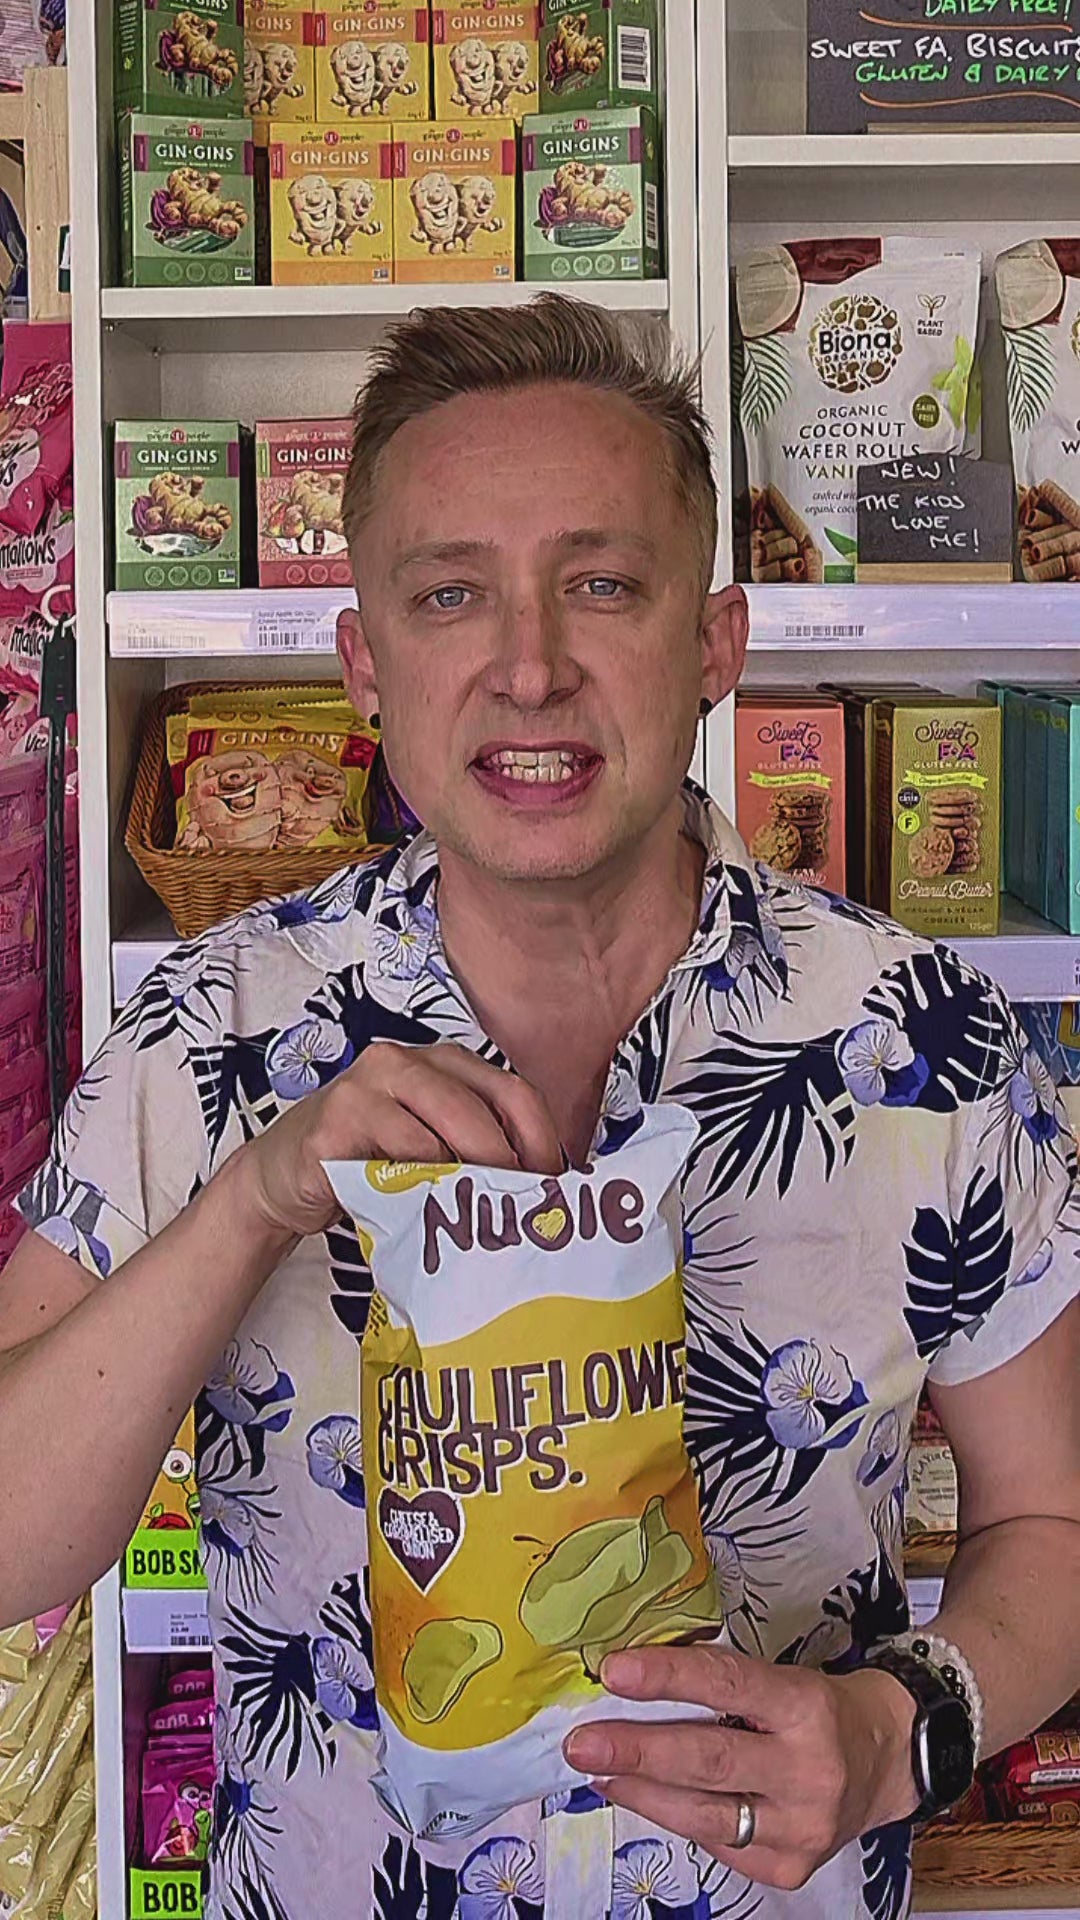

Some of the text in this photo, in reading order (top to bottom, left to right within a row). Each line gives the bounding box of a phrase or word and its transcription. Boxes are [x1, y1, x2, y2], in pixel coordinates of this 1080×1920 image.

[811, 38, 902, 59] SWEET
[856, 61, 949, 83] GLUTEN
[996, 63, 1070, 84] DAIRY
[917, 319, 944, 328] PLANT
[818, 328, 892, 355] Biona
[824, 350, 886, 364] ORGANIC
[817, 404, 888, 420] ORGANIC
[799, 422, 906, 439] COCONUT
[782, 443, 921, 459] WAFER ROLLS
[858, 494, 900, 511] THE
[891, 516, 950, 530] LOVE
[757, 720, 822, 748] Sweet
[915, 719, 979, 748] Sweet
[898, 879, 994, 900] Peanut Butter
[422, 1175, 645, 1276] Nudie
[377, 1425, 586, 1495] CRISPS.
[143, 1882, 198, 1914] BOB
